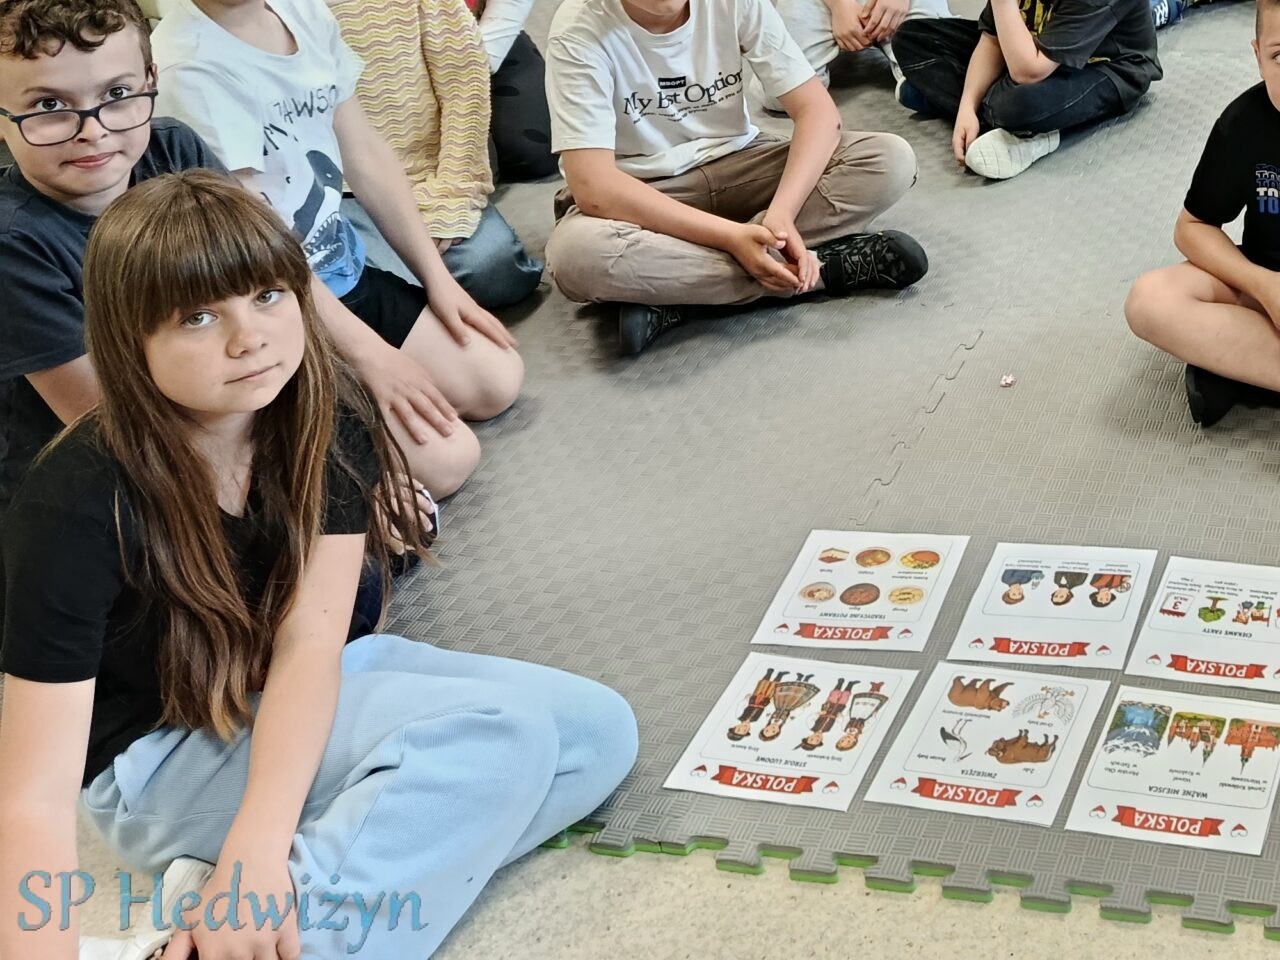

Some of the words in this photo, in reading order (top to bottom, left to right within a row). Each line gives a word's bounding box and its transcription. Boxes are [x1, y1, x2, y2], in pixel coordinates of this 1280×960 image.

[623, 92, 652, 115] My
[1172, 601, 1181, 609] 3
[814, 626, 873, 640] POLSKA
[1225, 630, 1252, 638] CIEKAWE
[1009, 641, 1070, 656] POLSKA
[1186, 659, 1247, 677] POLSKA
[756, 756, 782, 765] LUDOWE
[785, 759, 807, 767] STROJE
[961, 769, 997, 779] ZWIERZĘTA
[731, 771, 797, 792] POLSKA
[933, 784, 999, 804] POLSKA
[1149, 786, 1179, 795] MIEJSCA
[1182, 789, 1208, 799] WAŻNE
[1134, 812, 1201, 834] POLSKA
